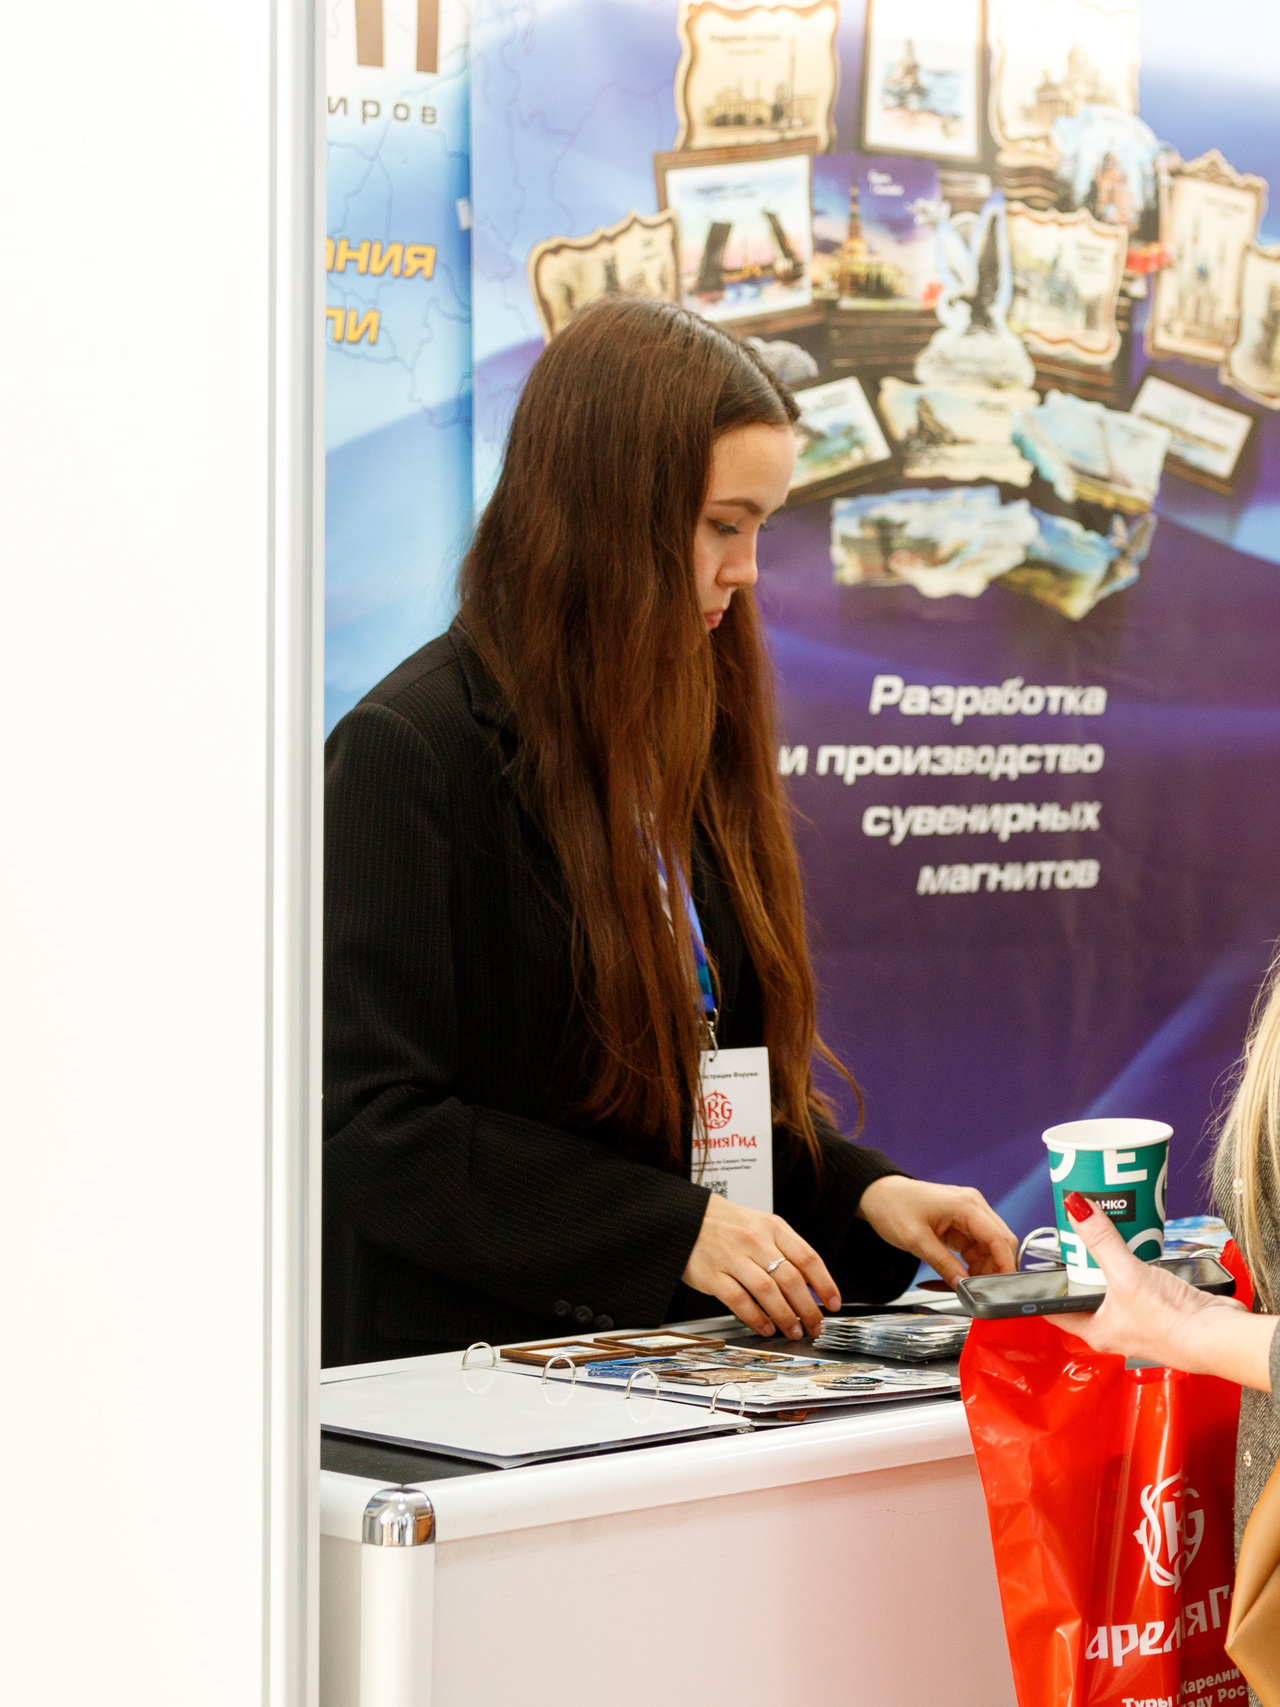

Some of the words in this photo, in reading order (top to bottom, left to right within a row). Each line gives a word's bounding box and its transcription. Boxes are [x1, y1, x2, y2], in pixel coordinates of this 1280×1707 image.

[869, 674, 1107, 725] Разработка
[777, 745, 809, 775] и
[816, 744, 1104, 785] производство
[861, 802, 1102, 846] сувенирных
[916, 859, 1099, 895] магнитов
